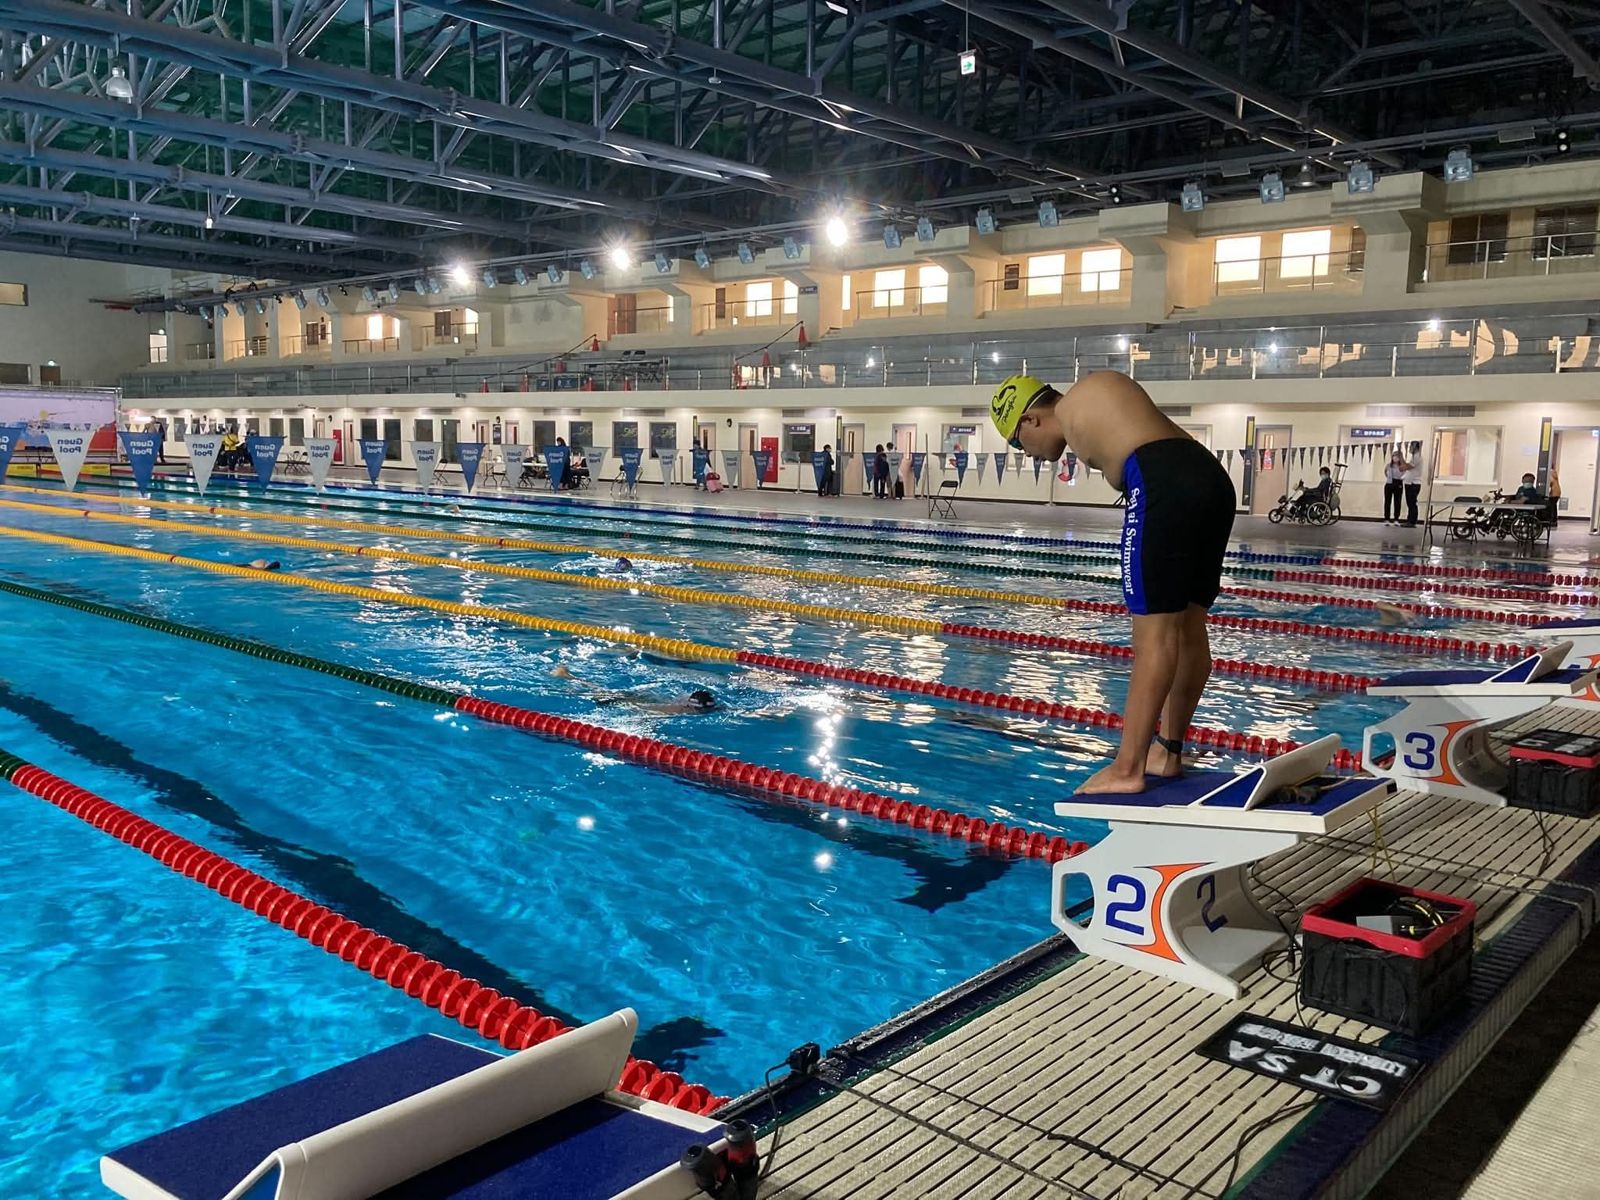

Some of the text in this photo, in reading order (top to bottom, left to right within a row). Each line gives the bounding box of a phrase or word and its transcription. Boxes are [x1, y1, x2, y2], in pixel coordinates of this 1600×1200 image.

[1123, 527, 1137, 595] Swimwear
[1404, 732, 1435, 770] 3
[1105, 874, 1146, 936] 2
